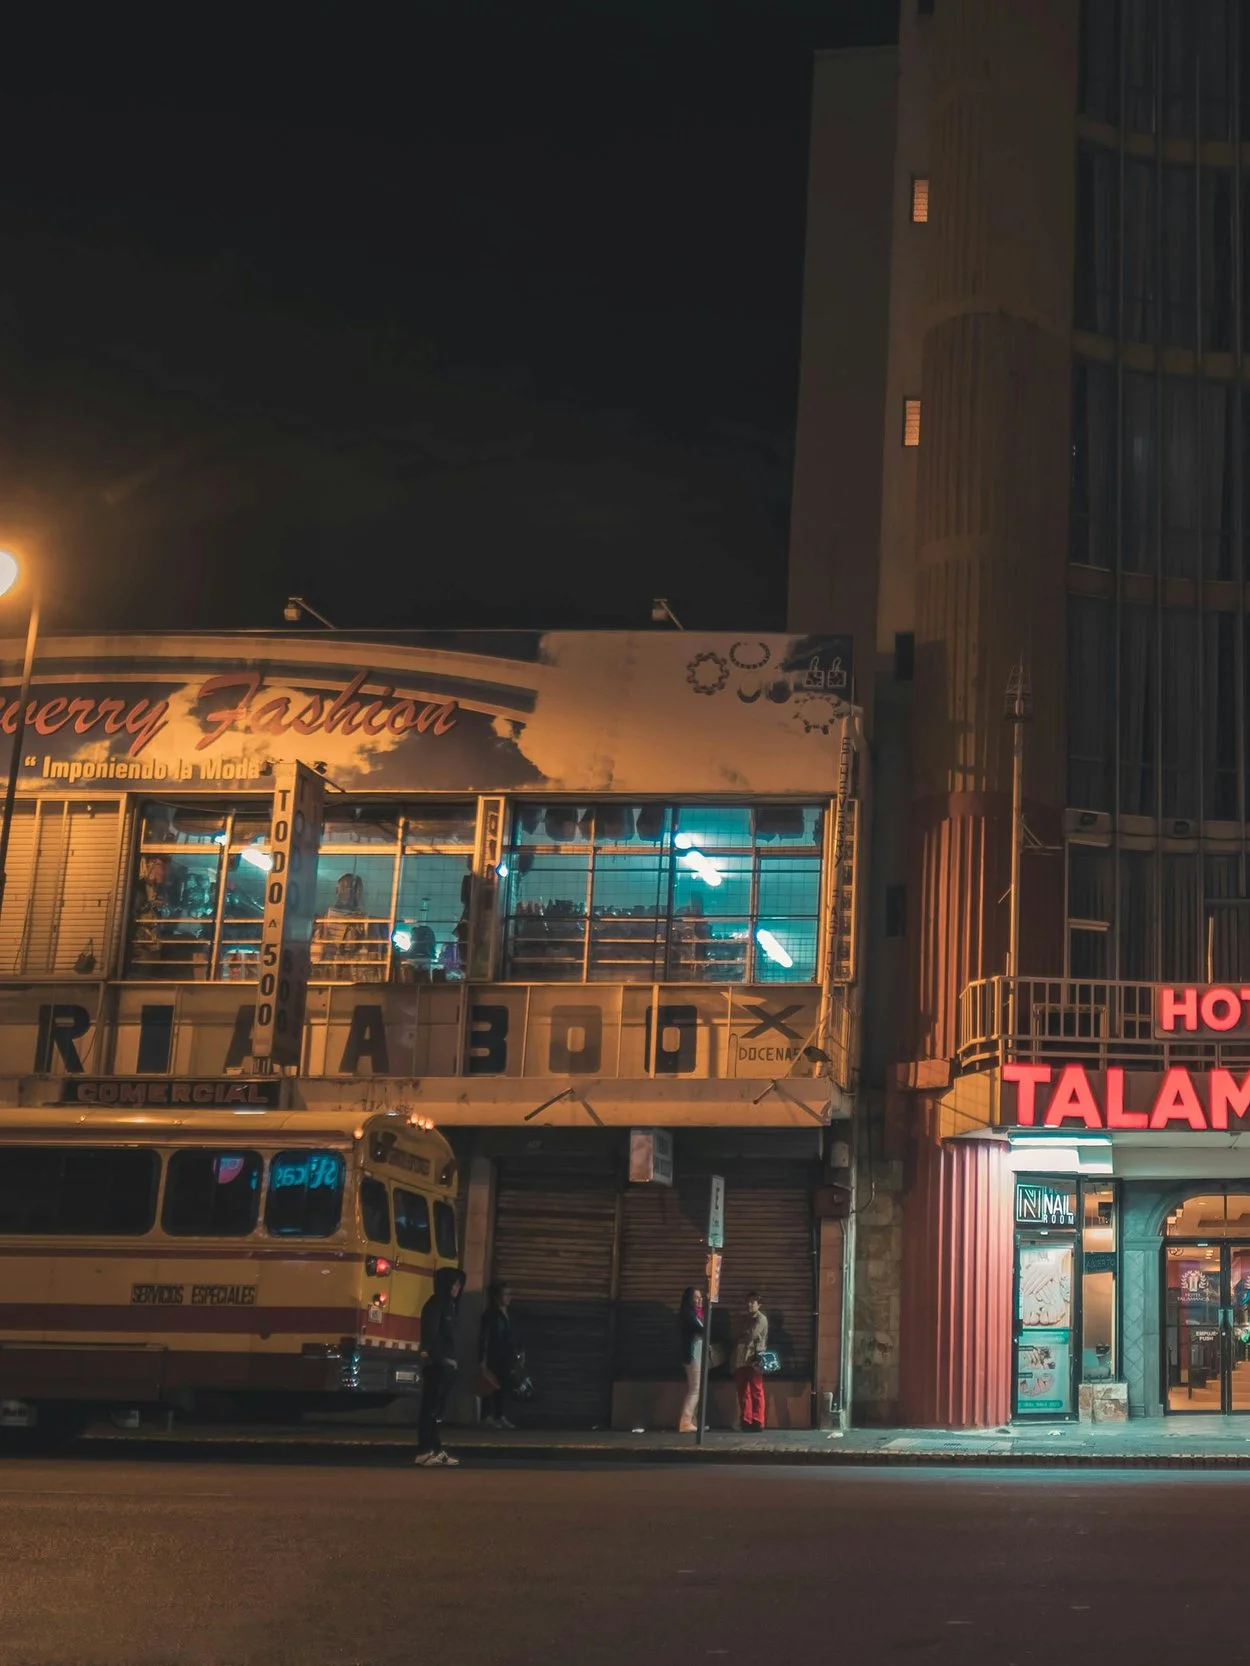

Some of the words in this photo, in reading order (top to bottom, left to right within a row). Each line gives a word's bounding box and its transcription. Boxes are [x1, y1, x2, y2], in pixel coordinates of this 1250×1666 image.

[196, 670, 458, 752] Fashion
[175, 758, 193, 781] la
[269, 788, 291, 905] TODO
[258, 942, 283, 1028] 500
[76, 1082, 268, 1105] COMERCIAL
[1044, 1193, 1073, 1216] NAIL
[1043, 1214, 1075, 1225] ROOM
[132, 1285, 184, 1304] SERVICIOS
[191, 1285, 255, 1306] ESPECIALES
